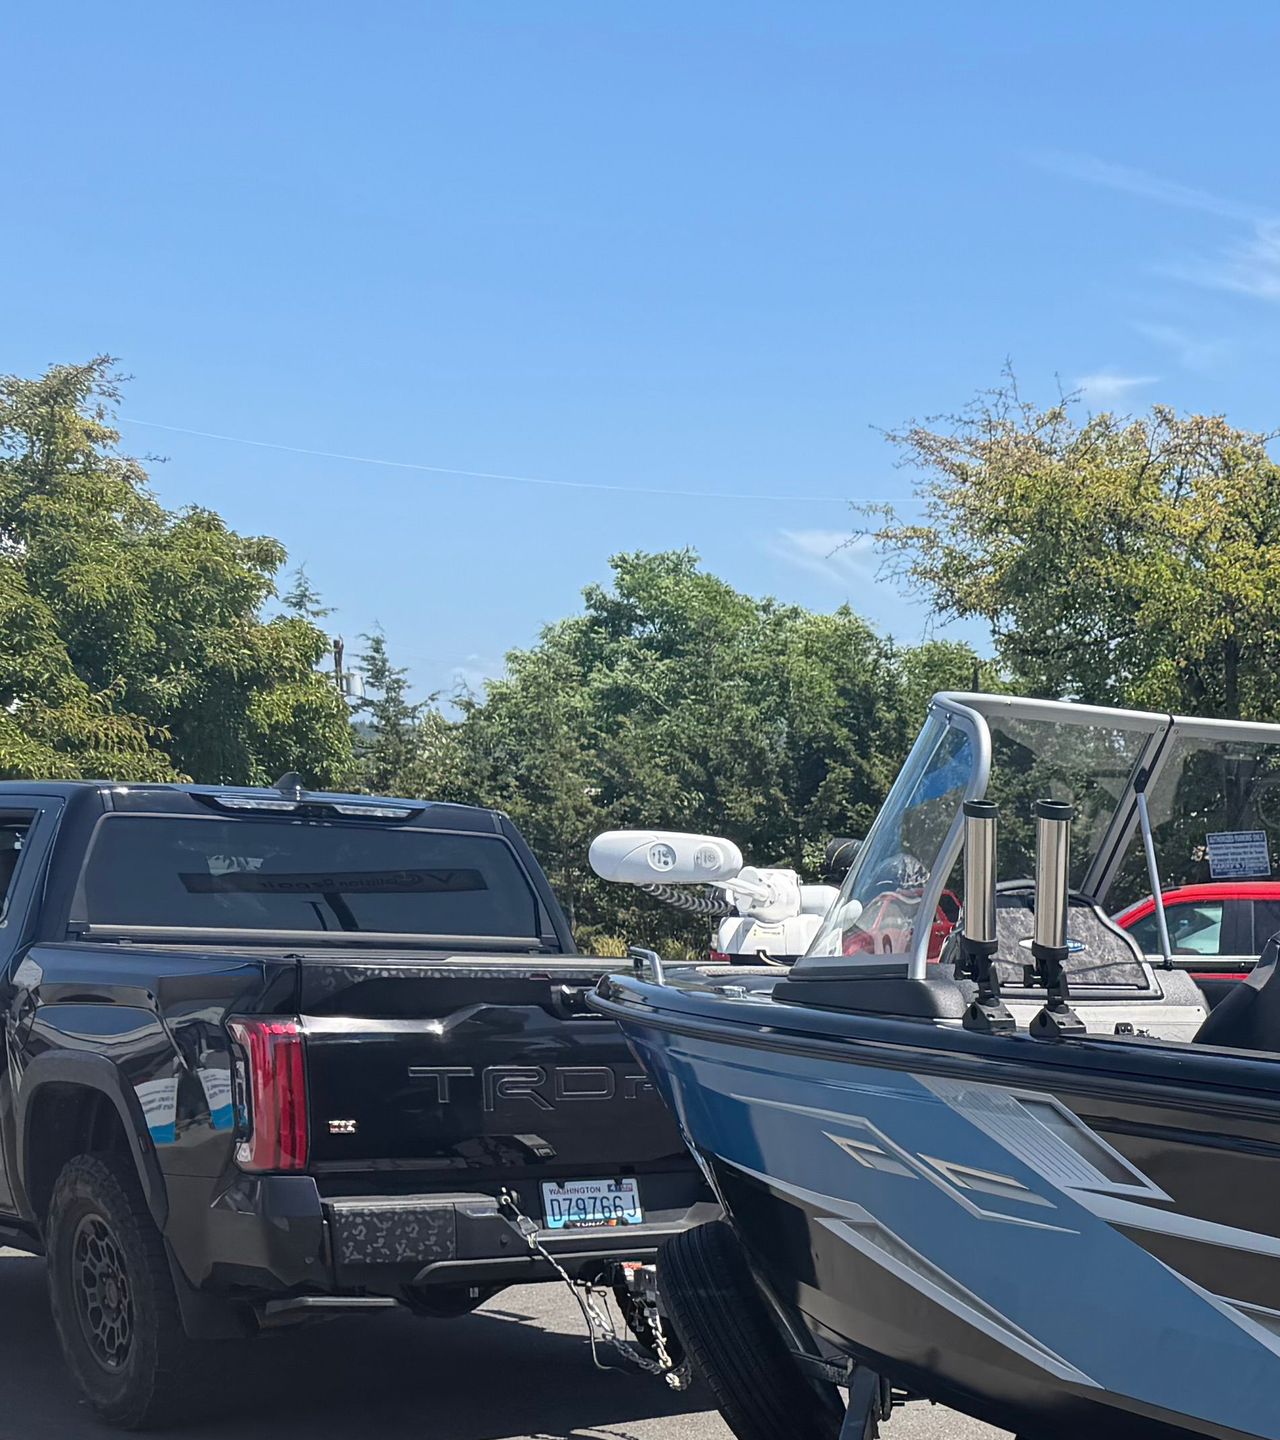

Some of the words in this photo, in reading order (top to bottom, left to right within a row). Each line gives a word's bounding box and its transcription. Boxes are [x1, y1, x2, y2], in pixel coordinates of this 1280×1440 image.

[407, 1065, 616, 1112] TRD
[549, 1186, 601, 1195] WASHINGTON
[550, 1195, 637, 1222] D79766J
